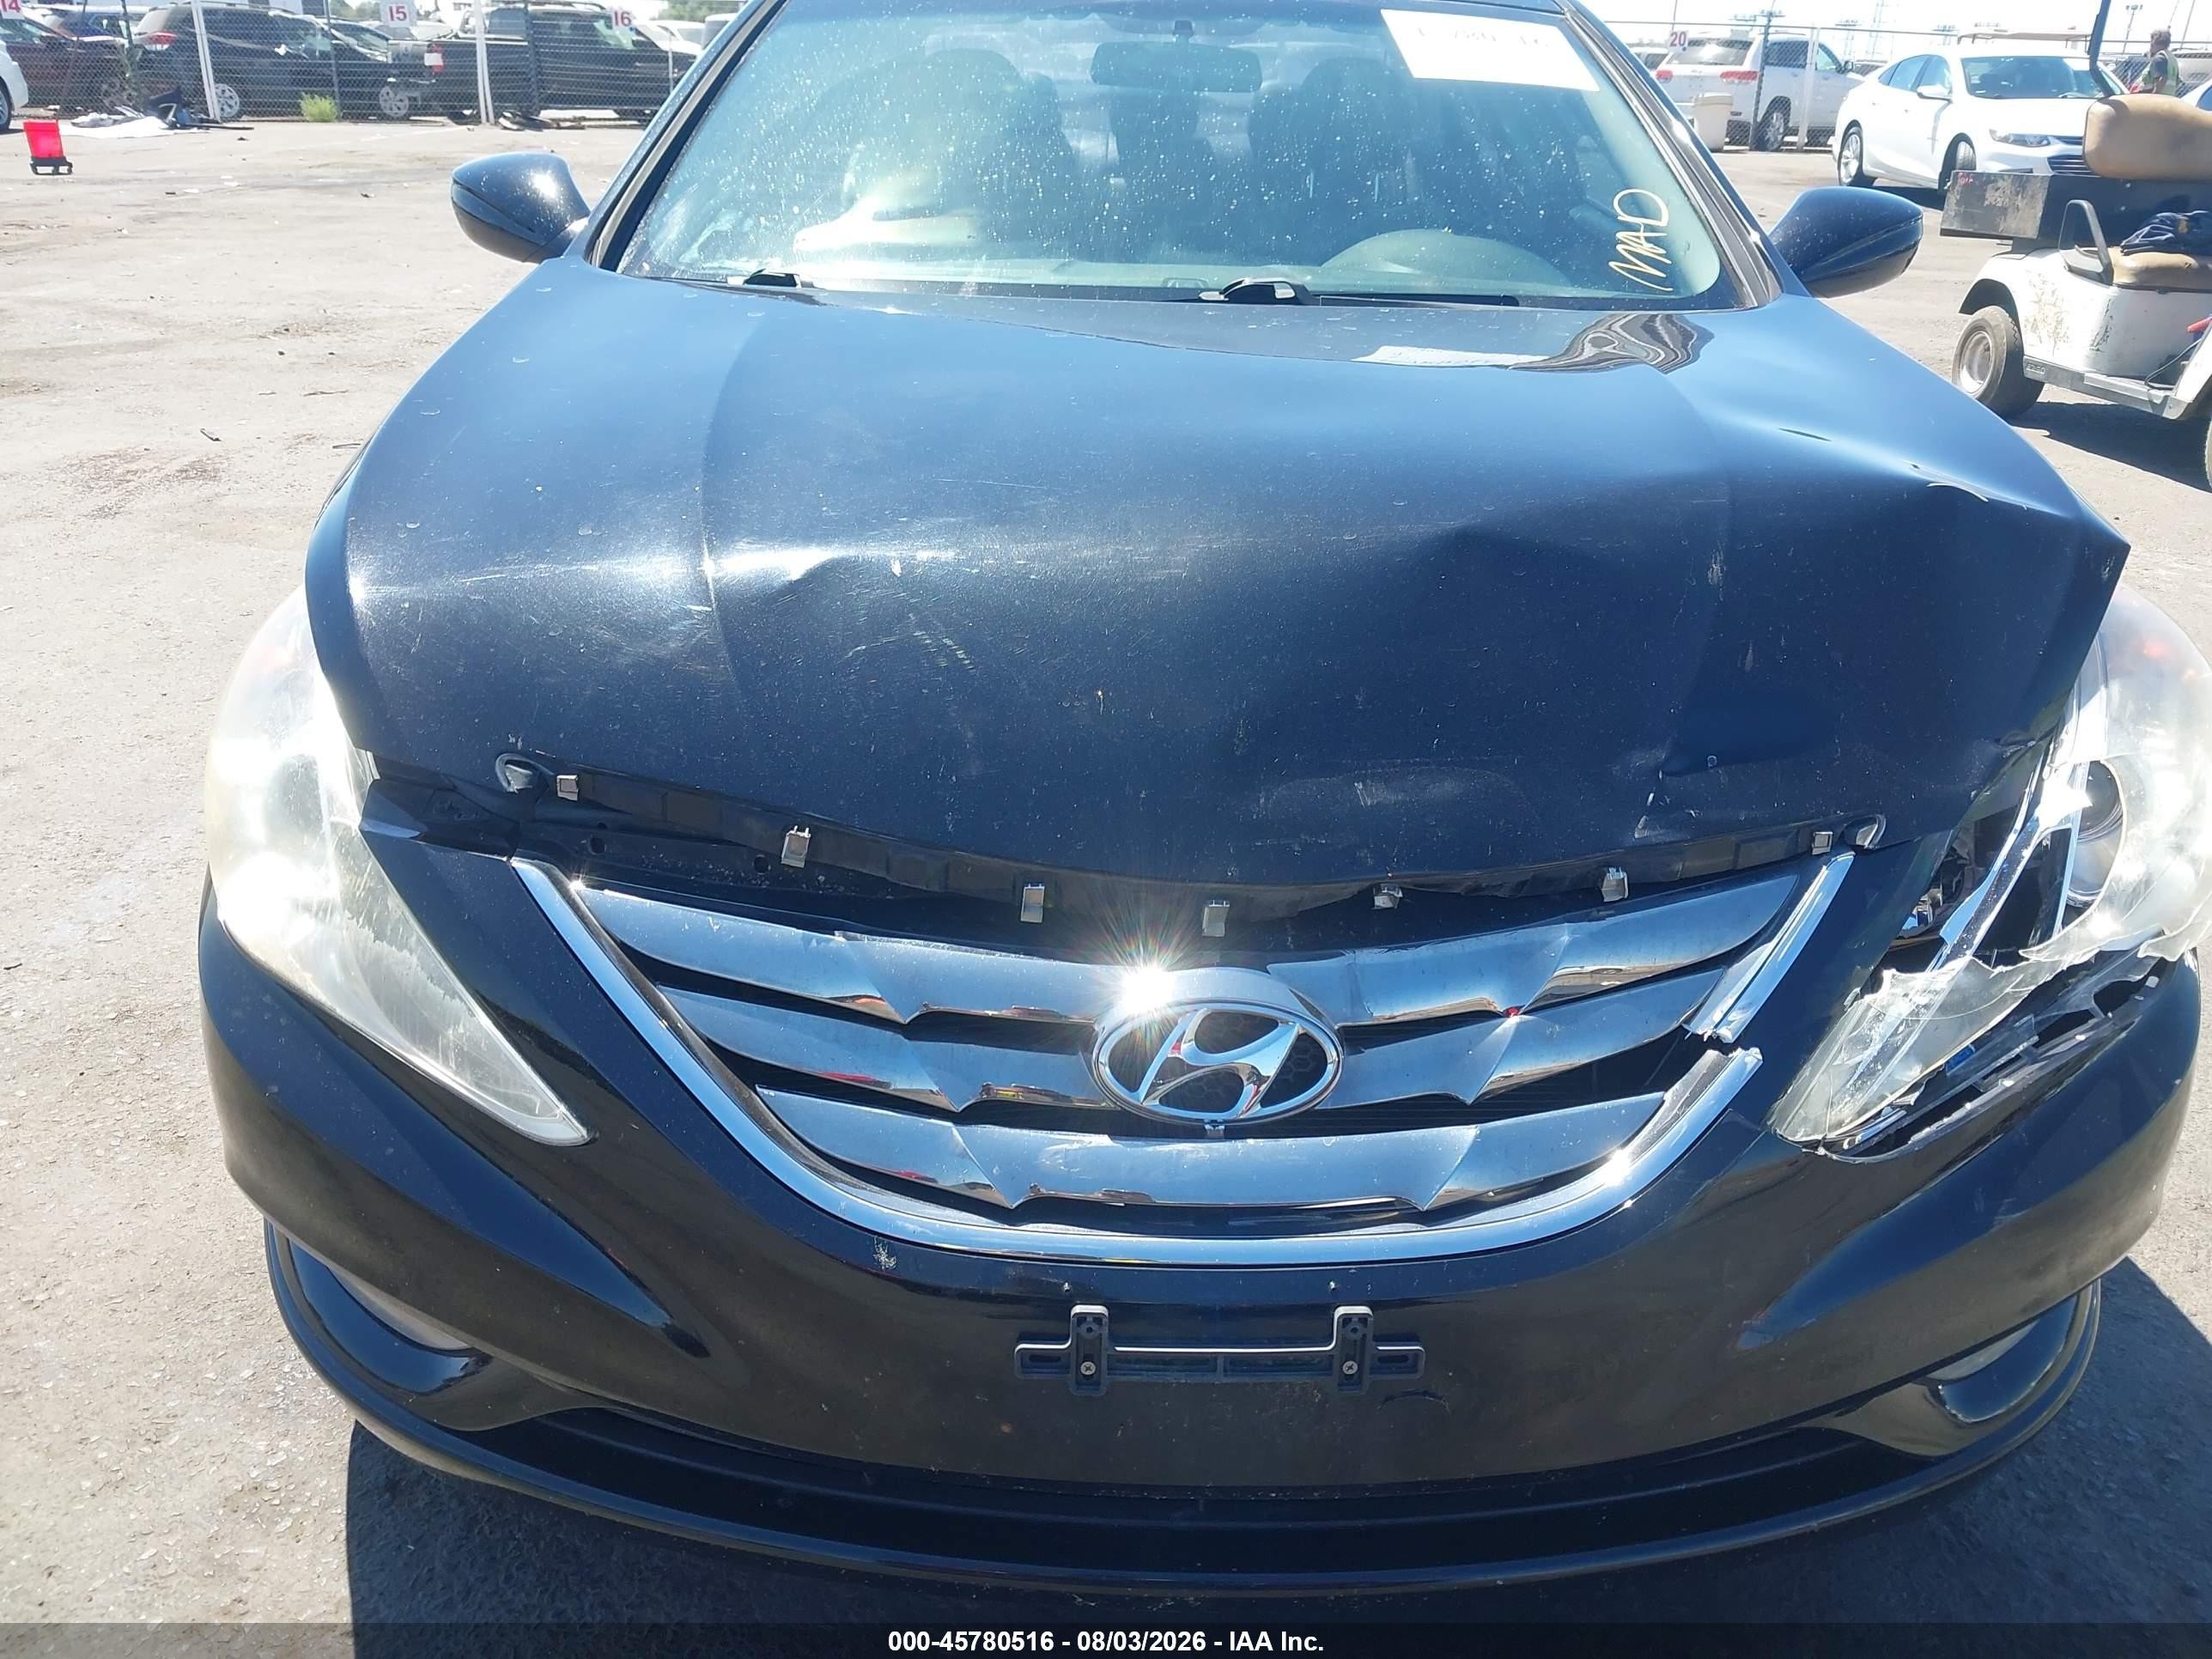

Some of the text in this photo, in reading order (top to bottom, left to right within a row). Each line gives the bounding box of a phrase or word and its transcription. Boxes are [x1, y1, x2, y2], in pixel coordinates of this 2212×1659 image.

[1, 0, 21, 13] 14
[388, 5, 408, 21] 15
[614, 10, 632, 27] 16
[1669, 31, 1687, 47] 20
